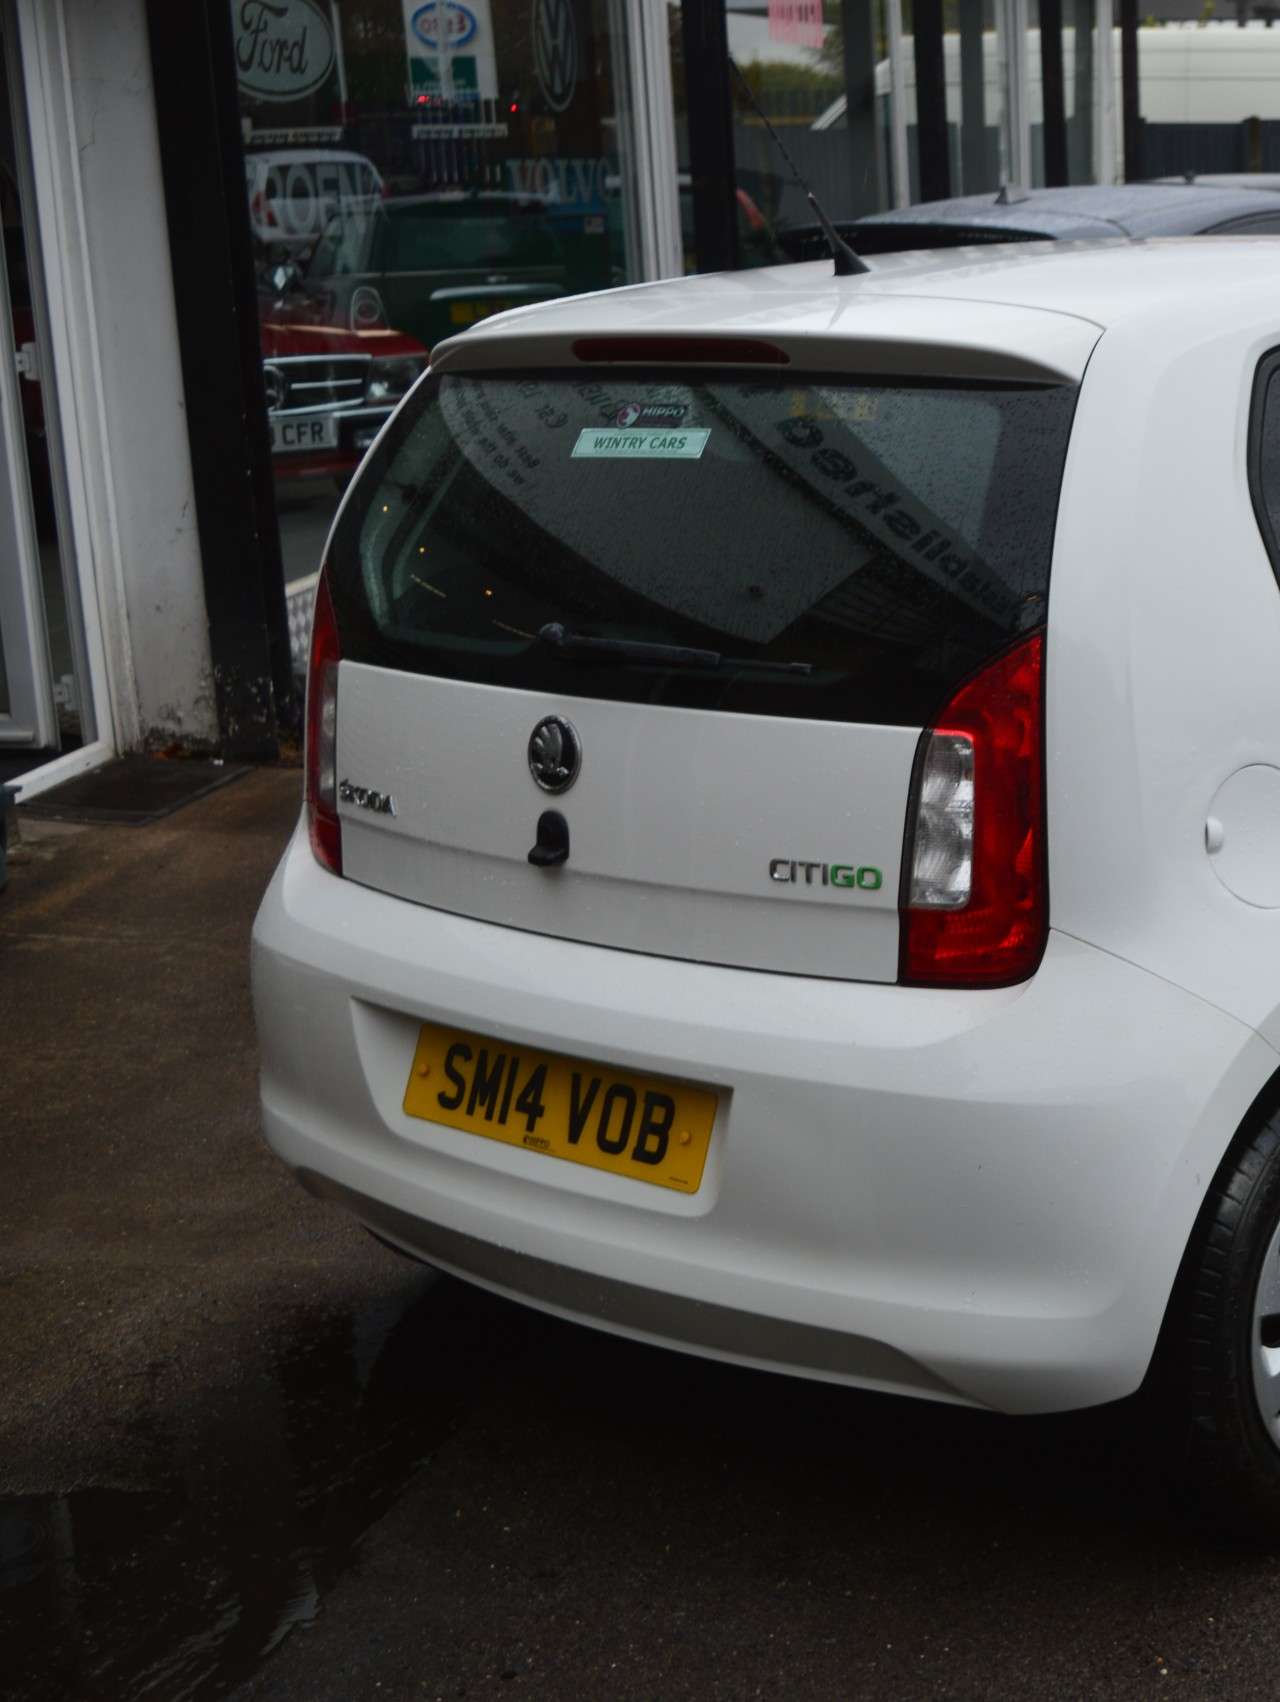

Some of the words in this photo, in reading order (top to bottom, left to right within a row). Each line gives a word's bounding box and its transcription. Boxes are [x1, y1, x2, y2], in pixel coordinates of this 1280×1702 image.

[236, 0, 308, 75] Ford
[282, 422, 324, 446] CFR
[592, 436, 647, 450] WINTRY
[649, 436, 688, 450] CARS
[769, 858, 883, 890] CITIGO
[437, 1042, 549, 1133] SM14
[567, 1072, 676, 1166] VOB
